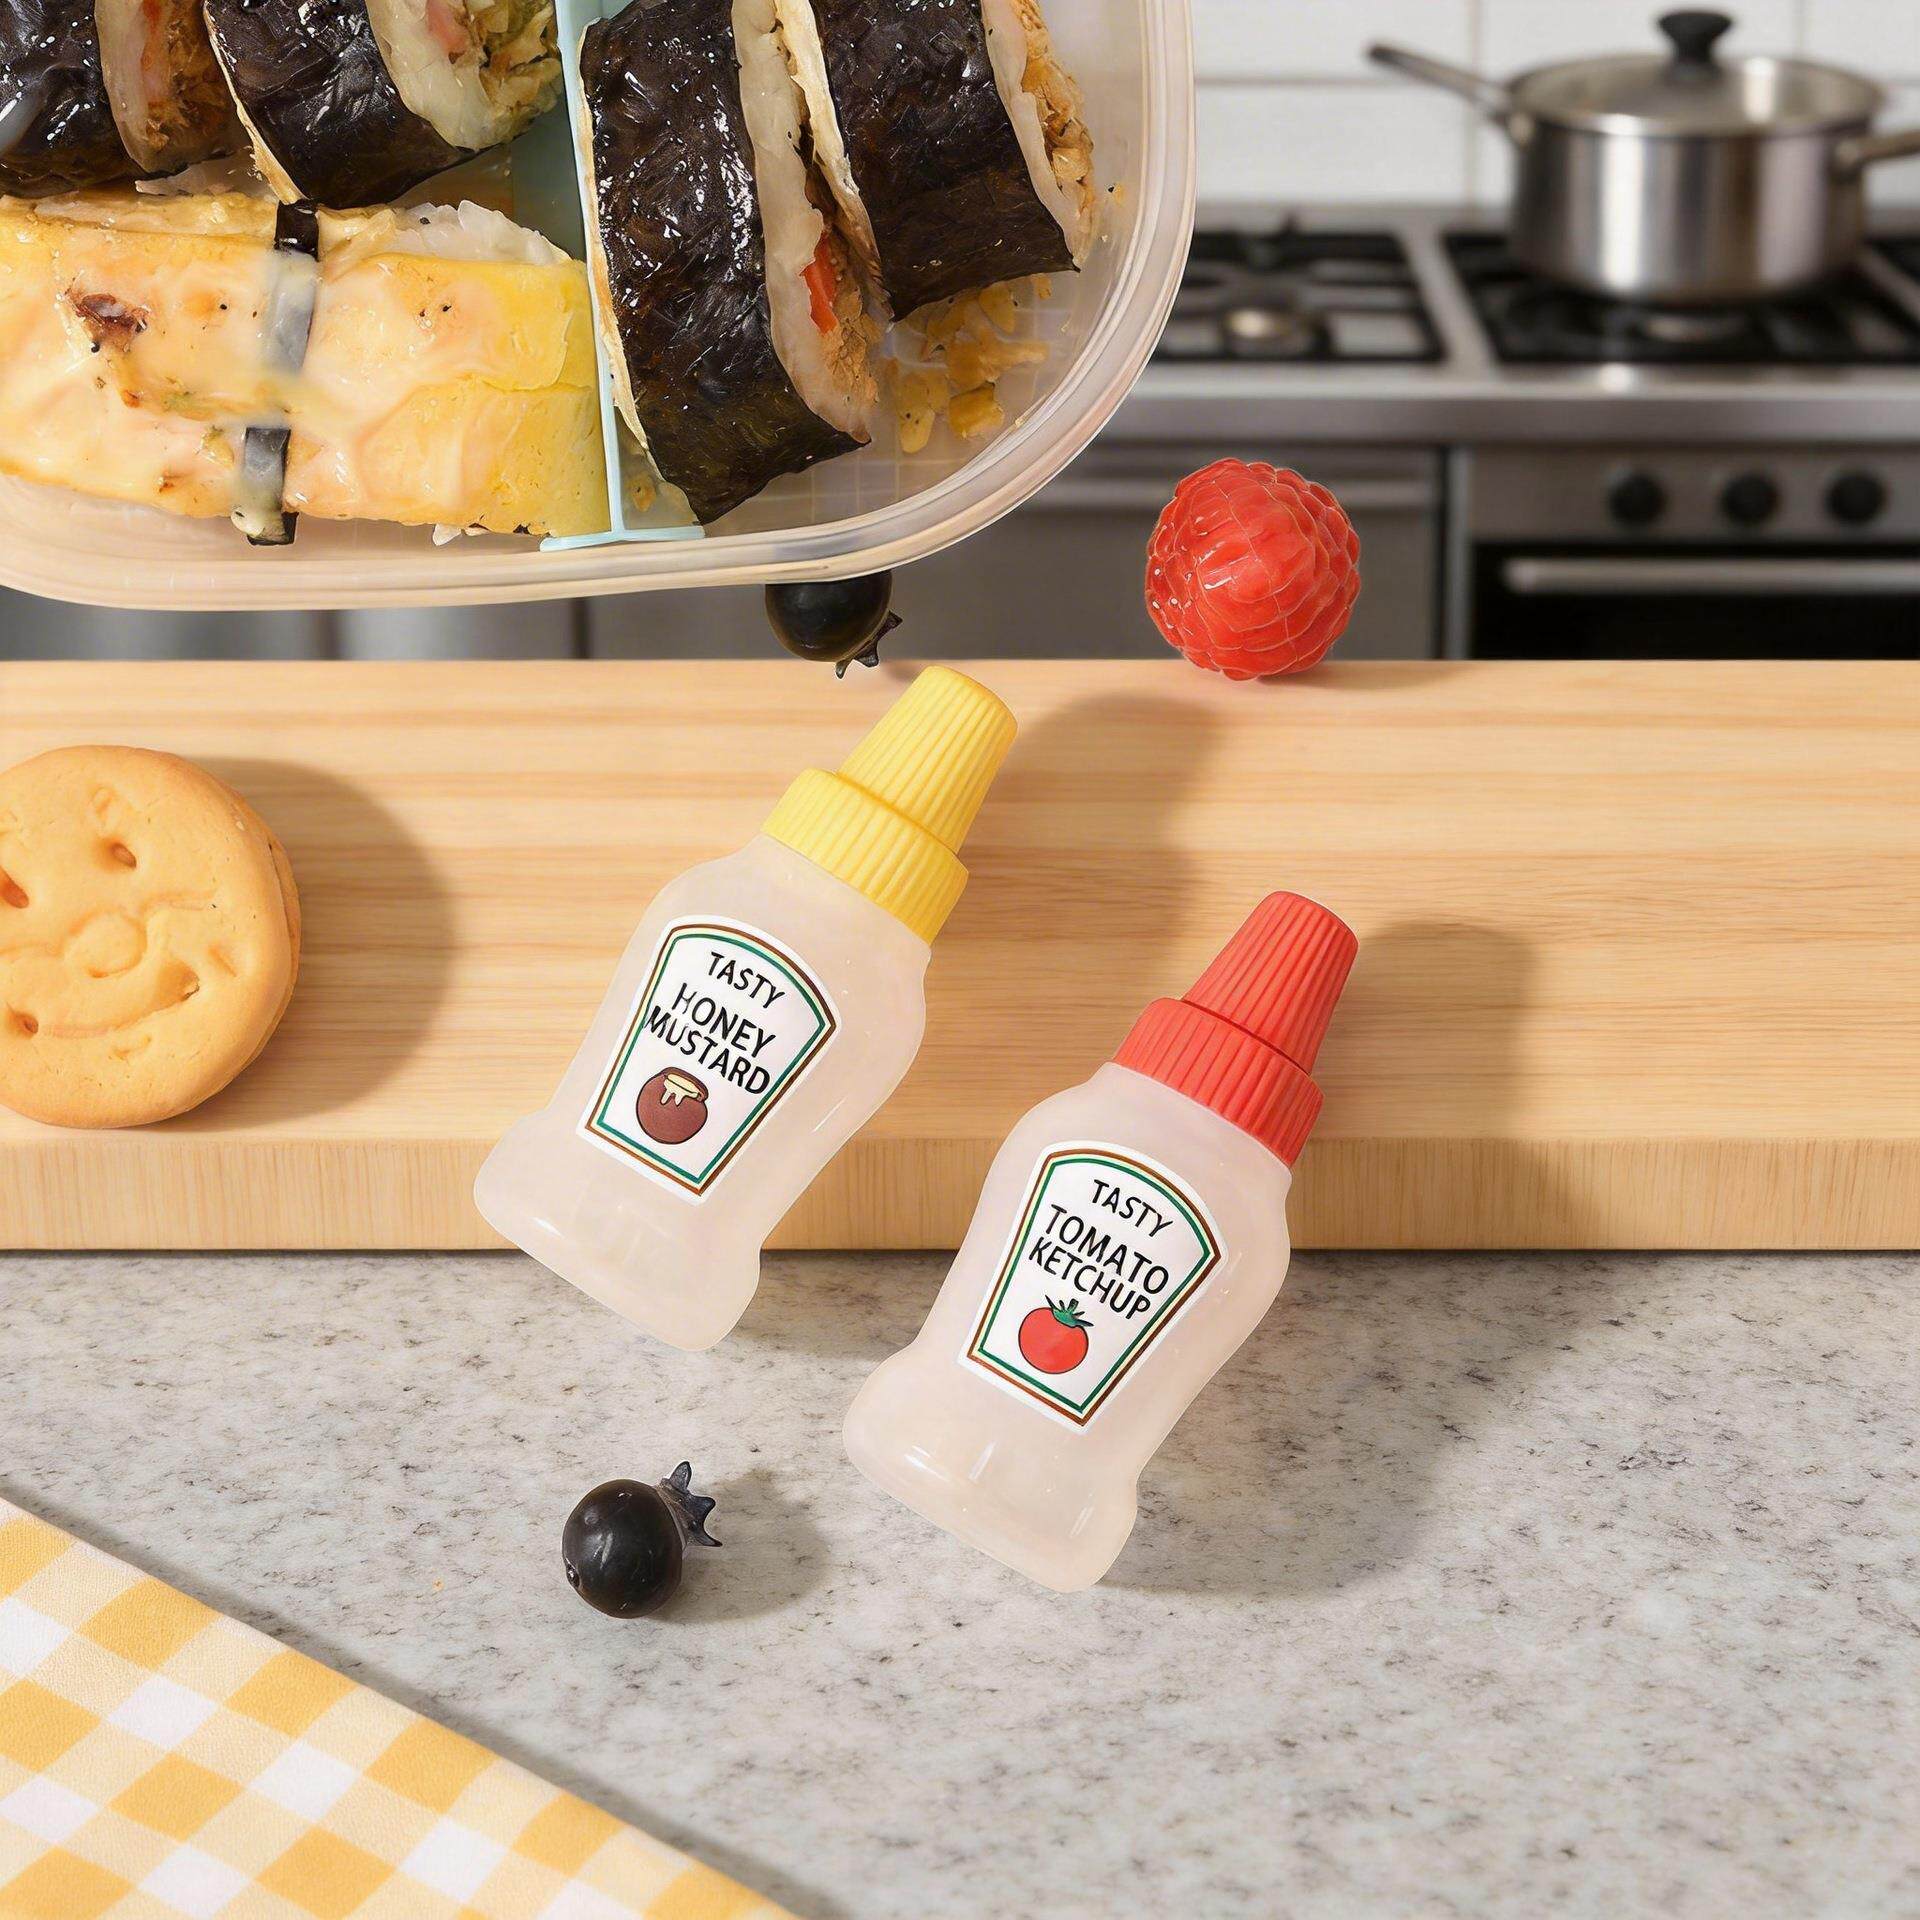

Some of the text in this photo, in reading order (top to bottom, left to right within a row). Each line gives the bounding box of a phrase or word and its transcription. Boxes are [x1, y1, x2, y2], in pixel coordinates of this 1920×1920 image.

[708, 951, 785, 1009] TASTY
[644, 1005, 770, 1095] MUSTARD
[671, 982, 776, 1058] HONEY
[1092, 1179, 1173, 1238] TASTY
[1028, 1237, 1151, 1320] KETCHUP
[1045, 1204, 1169, 1295] TOMATO
